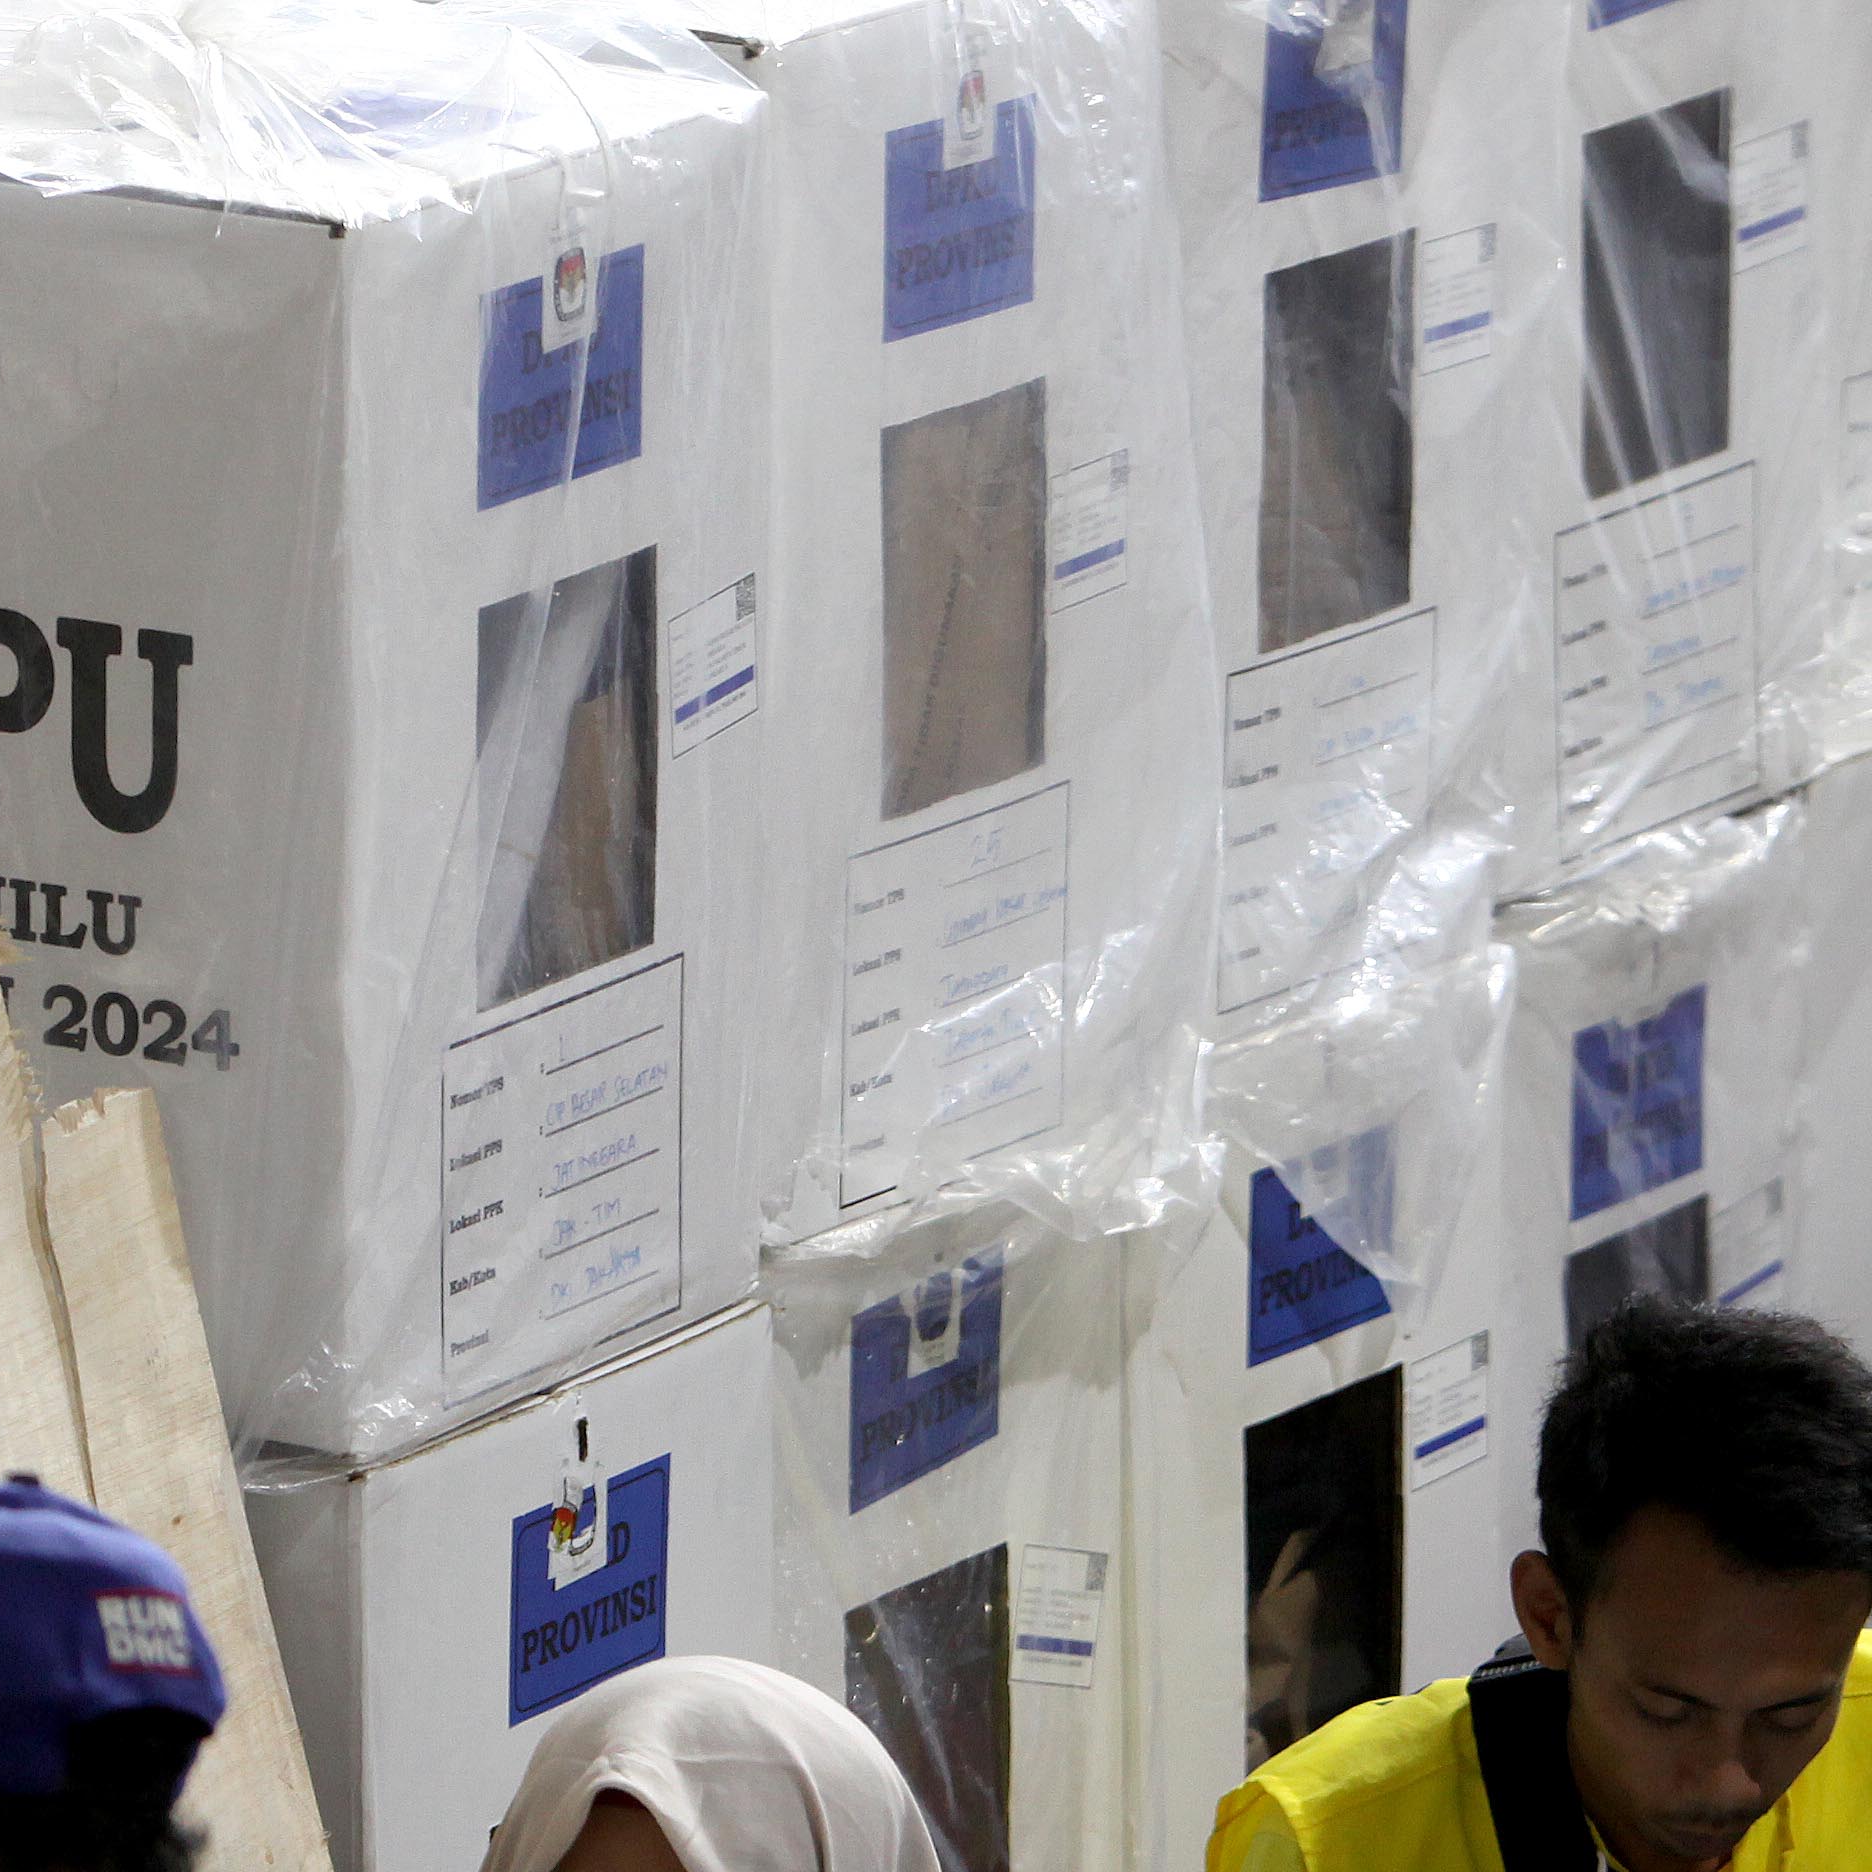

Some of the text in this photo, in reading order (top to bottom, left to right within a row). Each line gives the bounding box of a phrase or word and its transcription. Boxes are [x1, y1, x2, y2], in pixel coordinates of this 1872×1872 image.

[490, 368, 636, 457] PROVNSI
[42, 984, 239, 1072] 2024
[95, 1595, 186, 1634] RUN
[107, 1631, 193, 1669] DMC
[520, 1574, 658, 1674] PROVINSI
